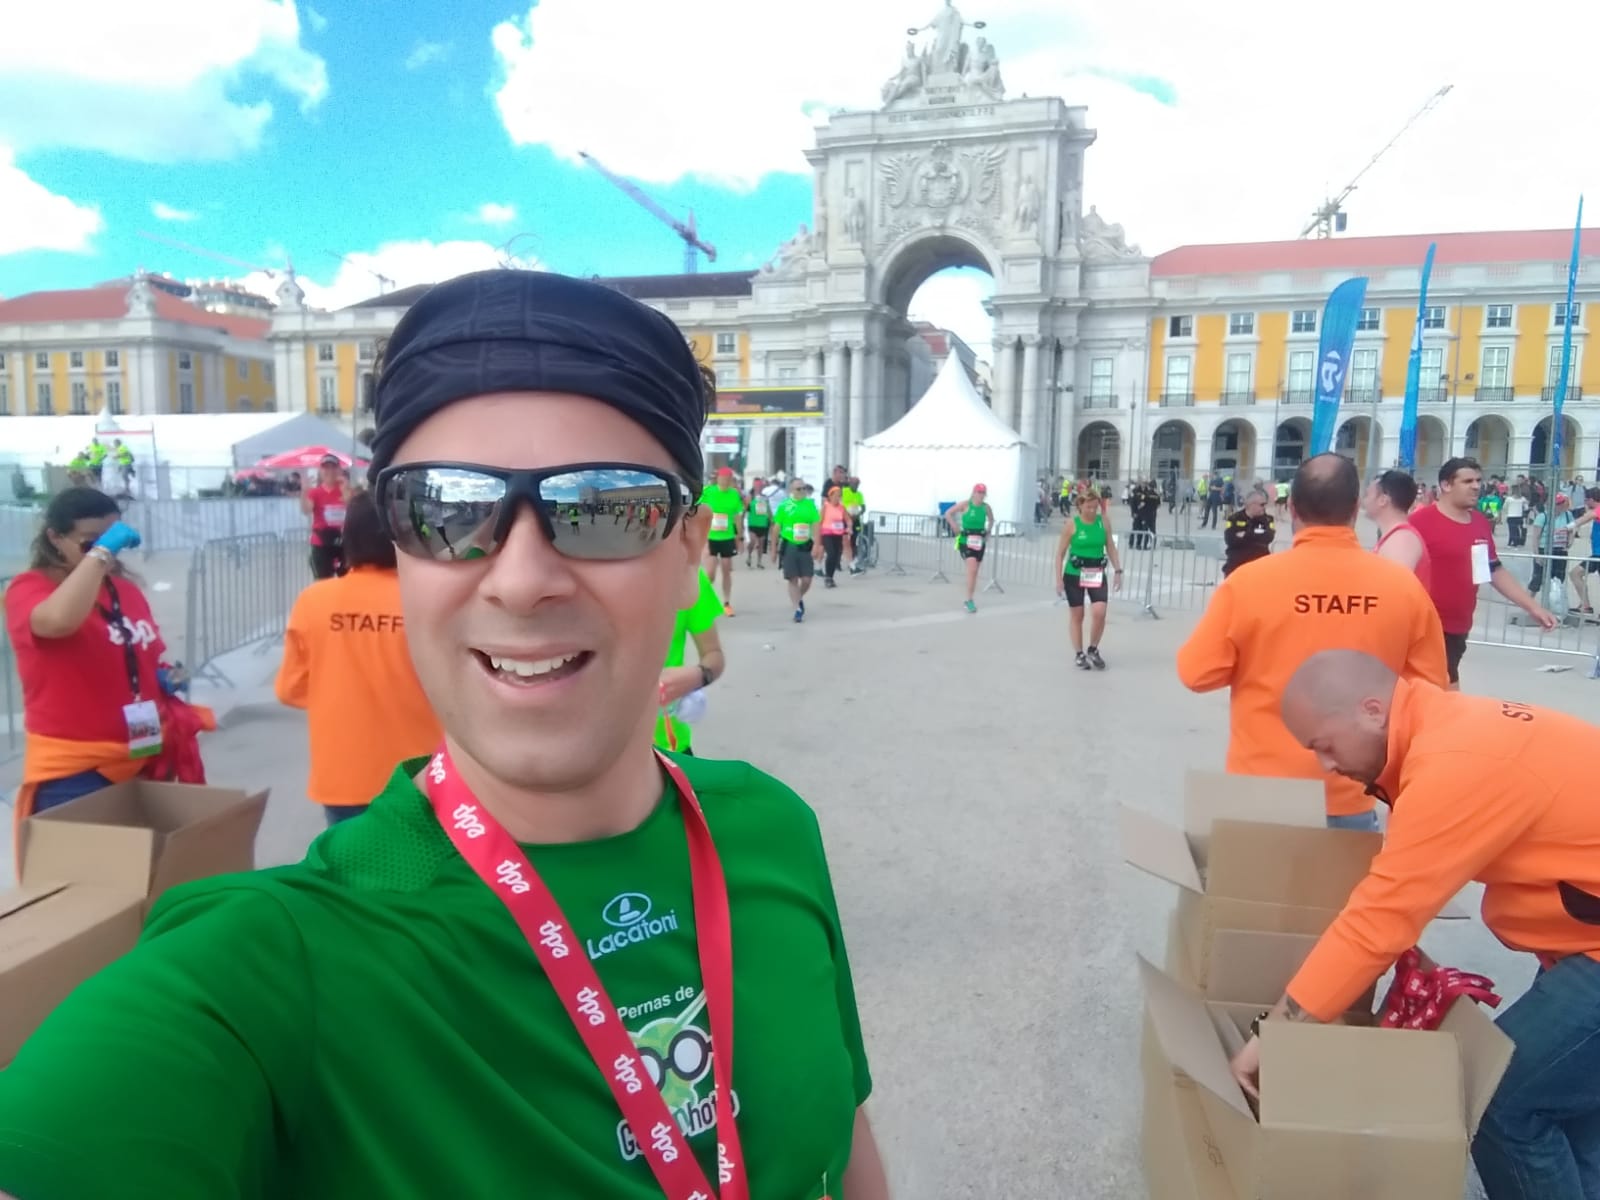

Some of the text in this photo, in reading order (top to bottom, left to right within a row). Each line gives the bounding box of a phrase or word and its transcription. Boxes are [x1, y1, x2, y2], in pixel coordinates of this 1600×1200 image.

[330, 613, 404, 633] STAFF
[1295, 594, 1379, 615] STAFF
[452, 803, 486, 839] edp
[496, 859, 530, 894] edp
[539, 920, 570, 959] edp
[586, 909, 678, 960] Lacatoni
[576, 986, 606, 1026] edp
[617, 986, 695, 1022] Pernas de
[613, 1053, 642, 1094] edp
[650, 1121, 679, 1163] edp
